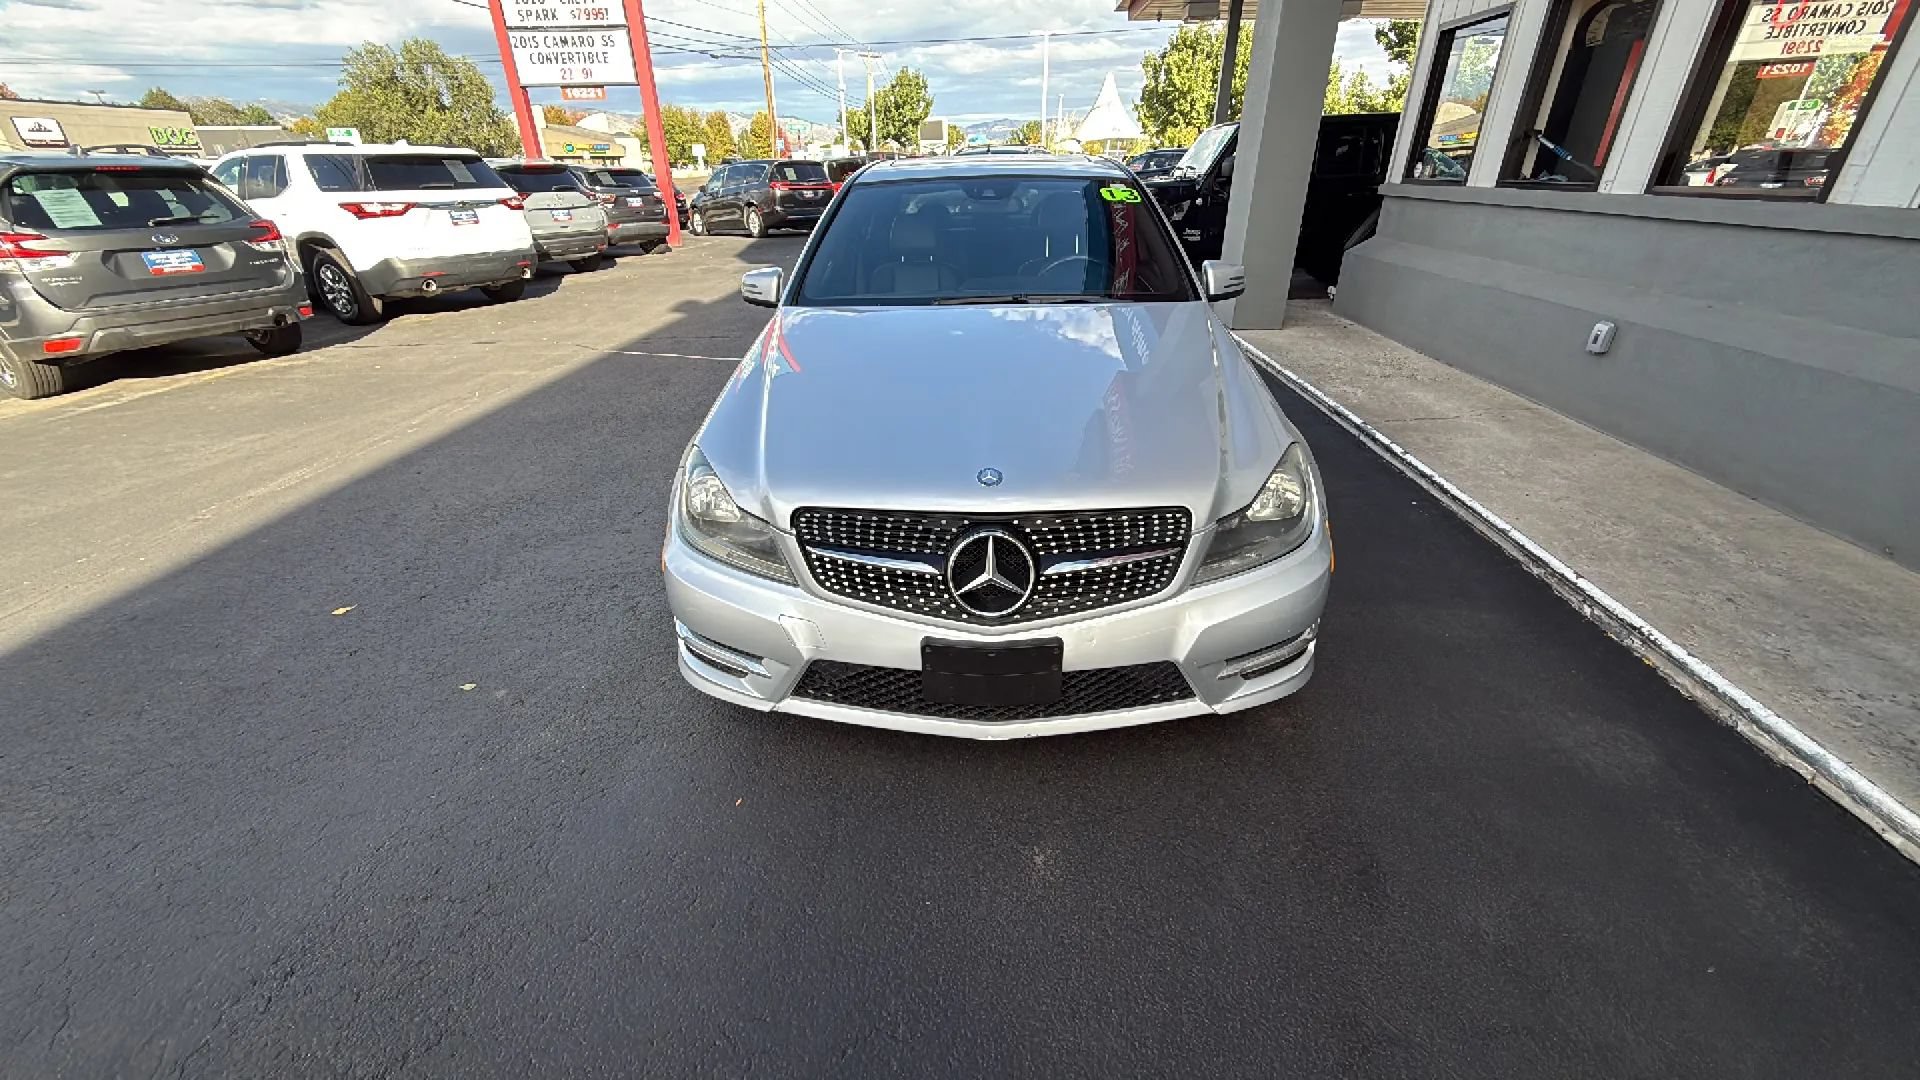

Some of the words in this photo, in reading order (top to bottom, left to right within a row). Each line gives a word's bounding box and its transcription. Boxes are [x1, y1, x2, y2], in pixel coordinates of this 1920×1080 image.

[517, 8, 559, 21] SPARK
[570, 8, 608, 20] $7995!
[512, 35, 539, 48] 2015
[543, 35, 594, 48] CAMARO
[601, 34, 615, 47] SS
[530, 51, 608, 64] CONVERTIBLE
[1102, 188, 1141, 202] 13
